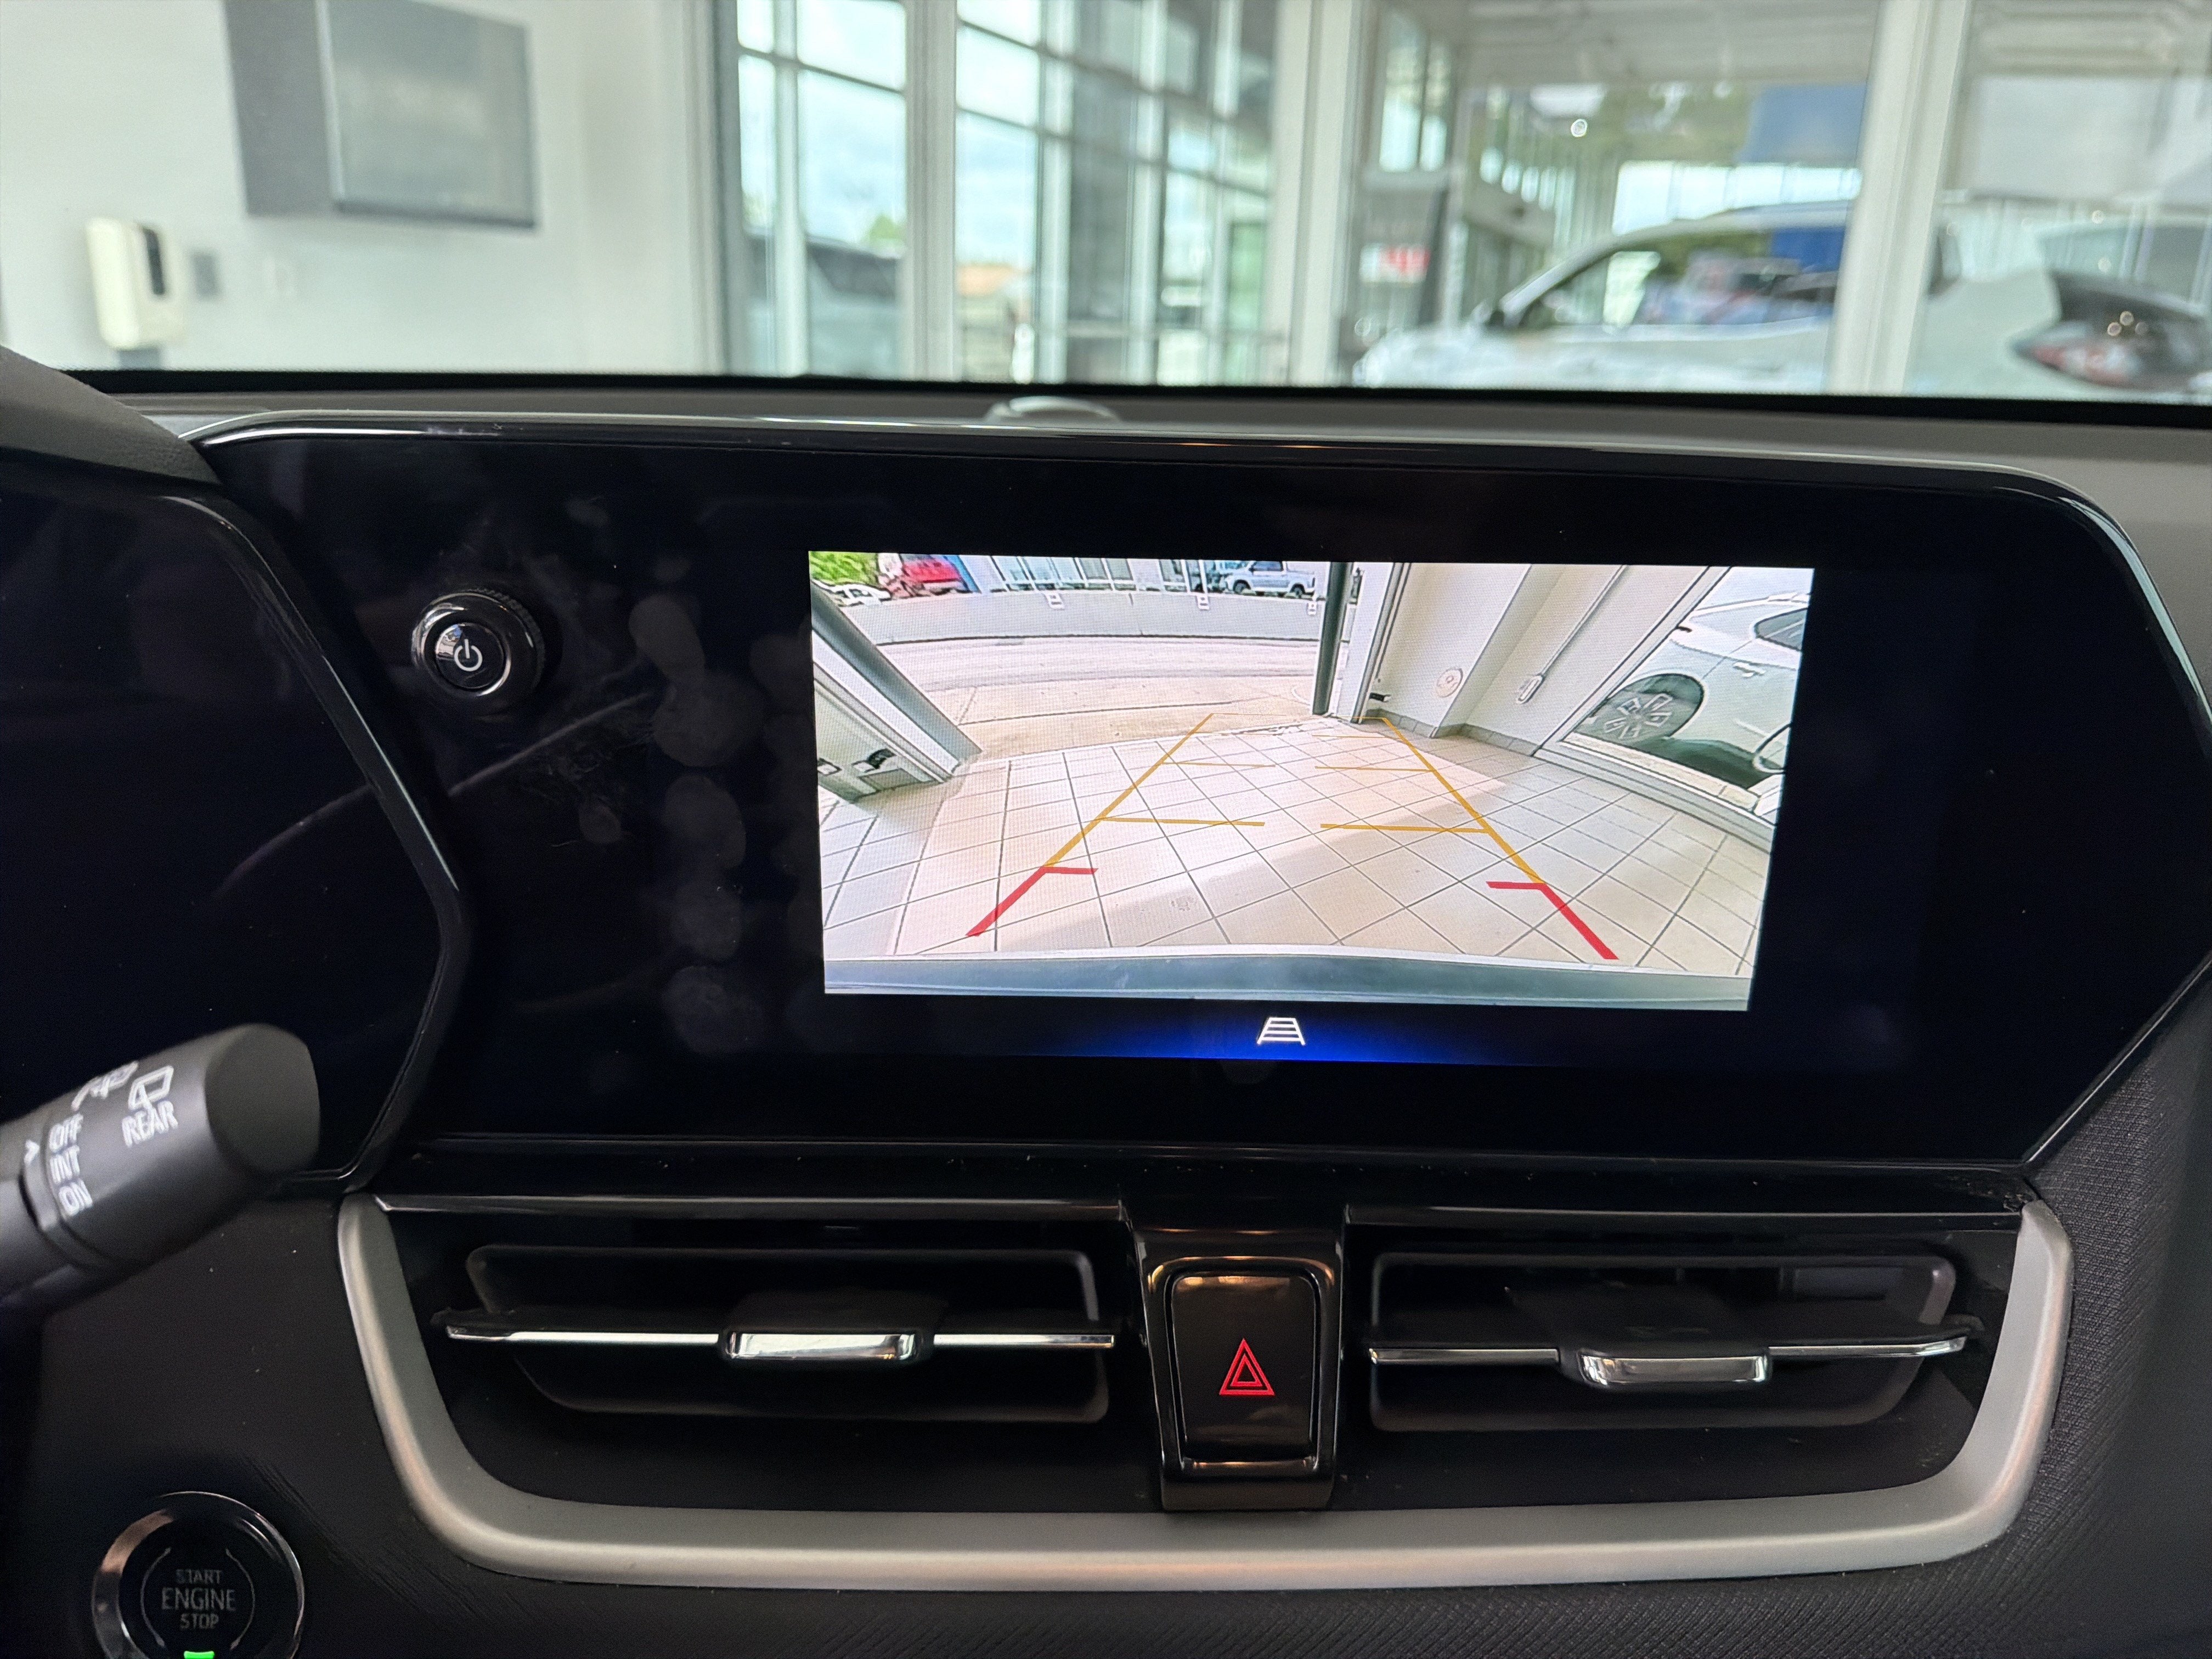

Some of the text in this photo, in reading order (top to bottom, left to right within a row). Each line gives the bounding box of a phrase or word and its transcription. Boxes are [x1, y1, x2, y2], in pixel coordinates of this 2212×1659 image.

[50, 1114, 83, 1150] OFF
[122, 1101, 178, 1147] REAR
[50, 1146, 80, 1182] INT
[59, 1180, 92, 1215] ON
[176, 1569, 222, 1584] START
[161, 1587, 236, 1611] ENGINE
[180, 1613, 219, 1630] STOP
